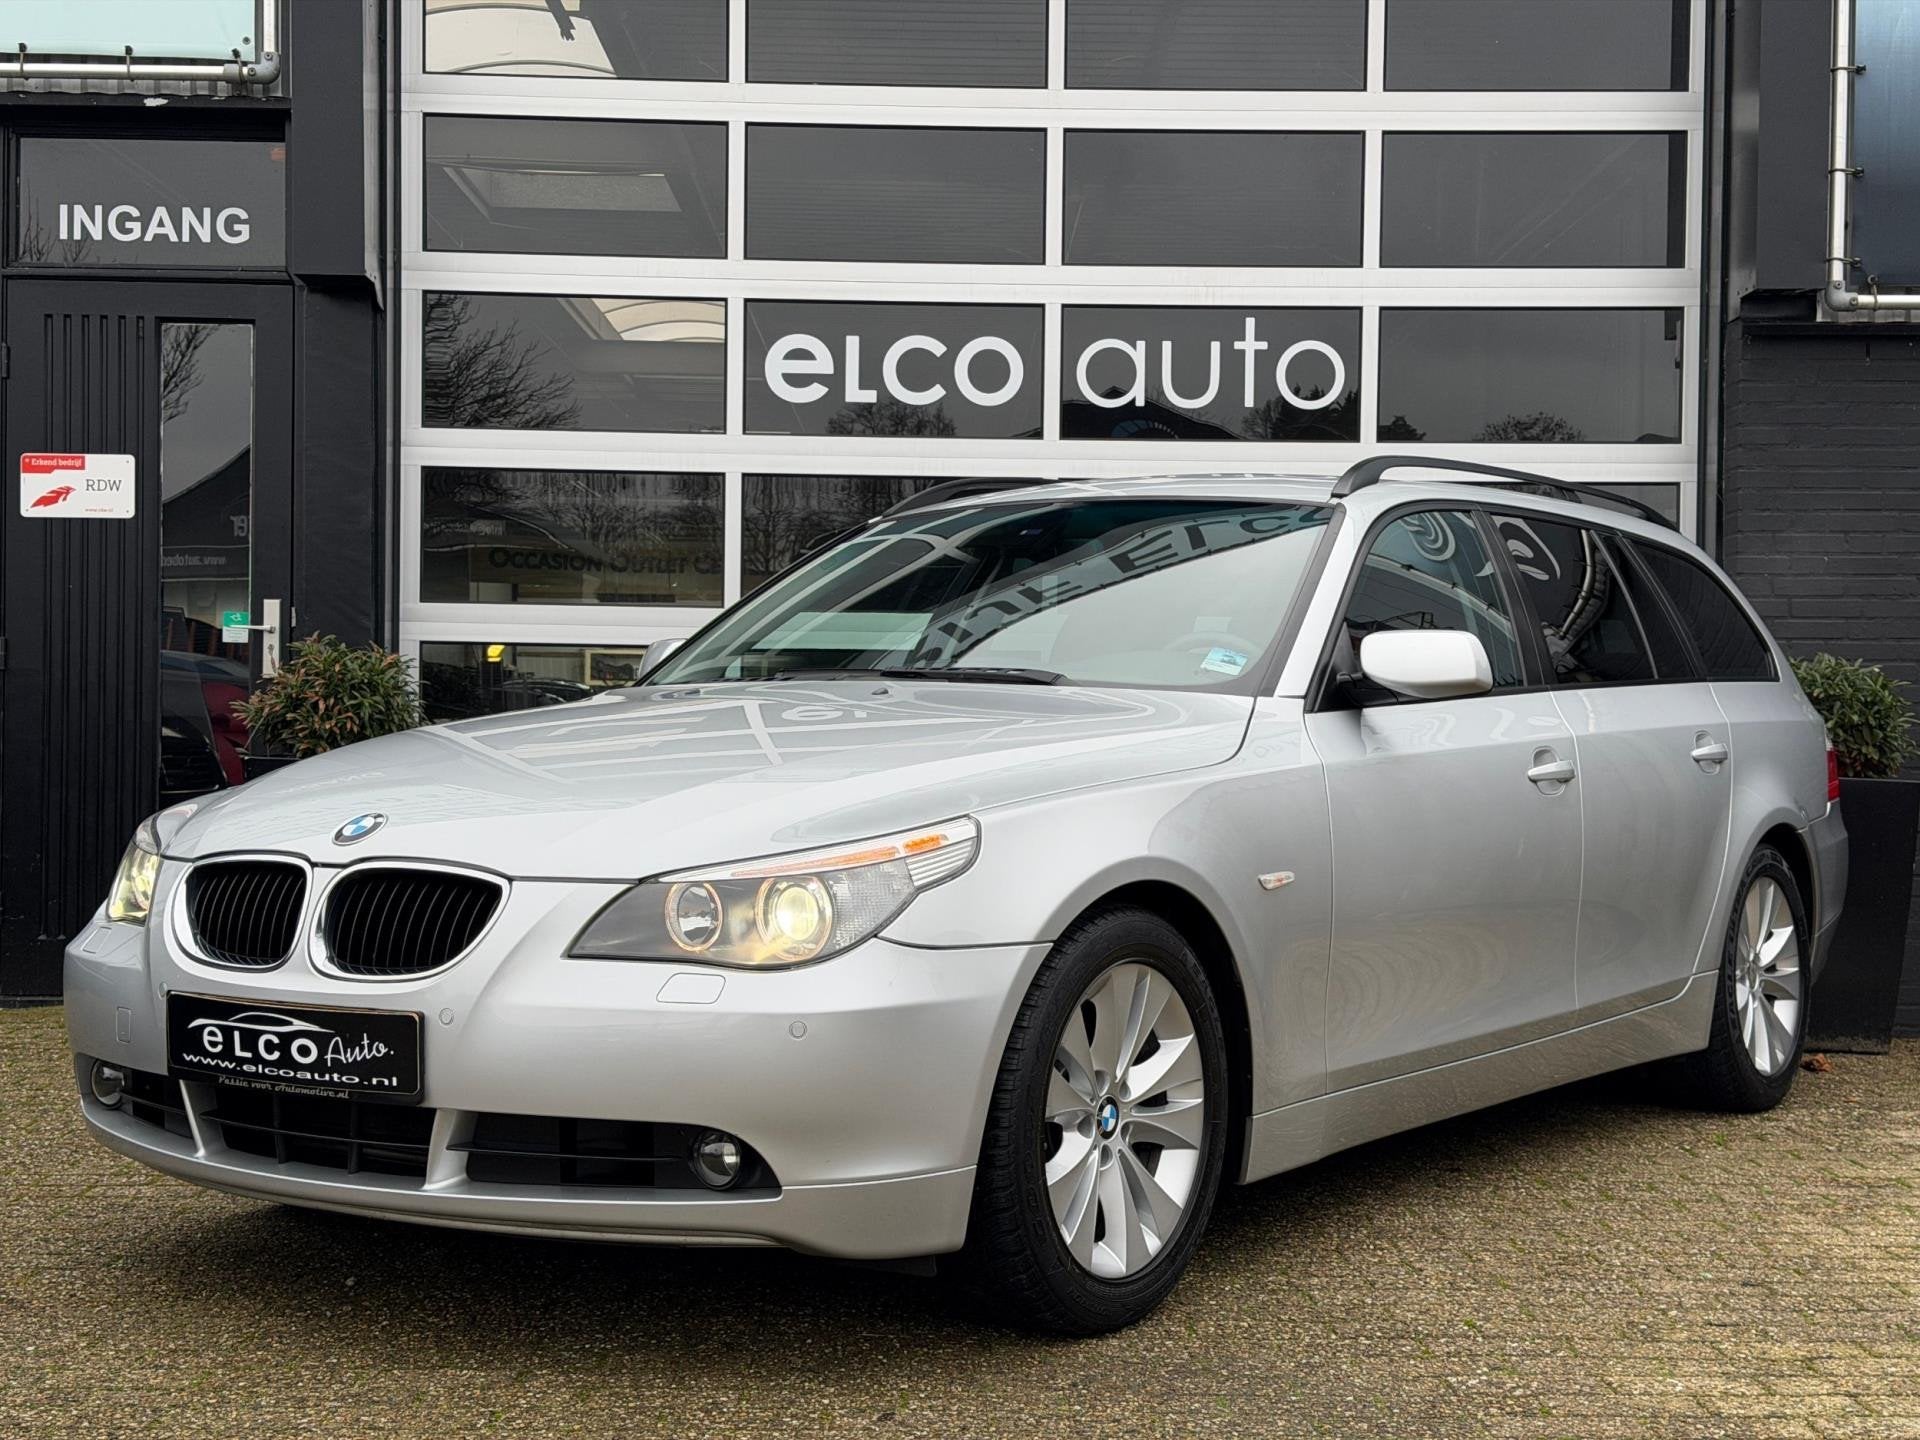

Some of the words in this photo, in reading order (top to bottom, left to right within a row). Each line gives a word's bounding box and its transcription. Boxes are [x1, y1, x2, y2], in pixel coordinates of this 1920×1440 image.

[59, 204, 250, 244] INGANG
[1076, 317, 1346, 411] auto
[31, 458, 57, 466] Erkend
[58, 458, 82, 468] bedrijf
[85, 479, 122, 492] RDW
[182, 1053, 399, 1087] www.elcoauto.nl
[218, 1076, 250, 1088] Passie
[251, 1080, 273, 1091] voor
[275, 1082, 350, 1100] Automotive.nl
